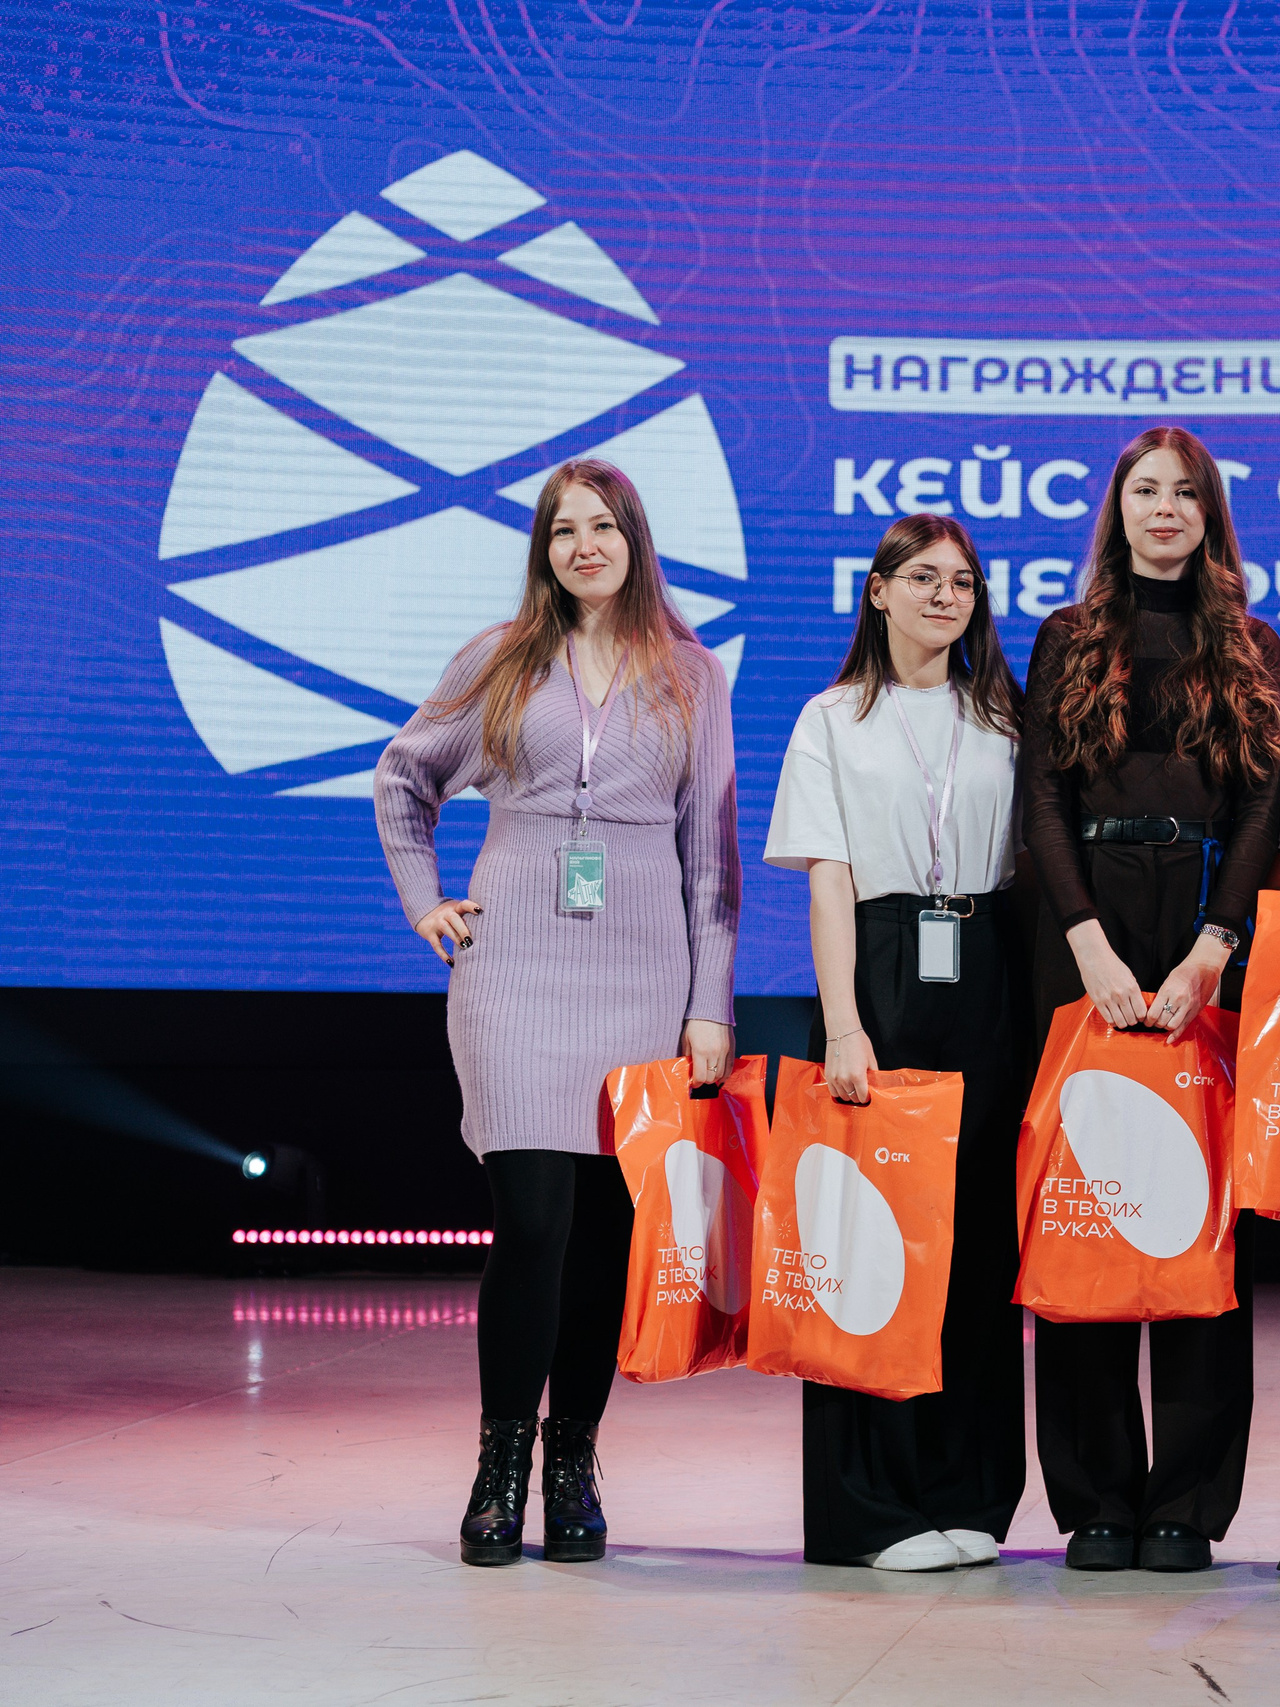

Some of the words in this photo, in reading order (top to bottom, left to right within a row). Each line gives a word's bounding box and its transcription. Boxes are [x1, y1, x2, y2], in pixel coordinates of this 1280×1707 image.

[832, 445, 1091, 519] КЕЙС
[1192, 1075, 1215, 1087] СГК
[890, 1151, 911, 1163] СГК
[1045, 1177, 1122, 1195] ТЕПЛО
[1042, 1198, 1058, 1214] В
[1064, 1199, 1143, 1218] ТВОИХ
[1041, 1220, 1115, 1239] РУКАХ
[657, 1245, 705, 1264] ТЕПЛО
[772, 1247, 827, 1270] ТЕПЛО
[657, 1269, 667, 1285] В
[669, 1265, 718, 1284] ТВОИХ
[765, 1268, 780, 1285] В
[785, 1271, 844, 1294] ТВОИХ
[656, 1287, 702, 1306] РУКАХ
[761, 1289, 817, 1313] РУКАХ
